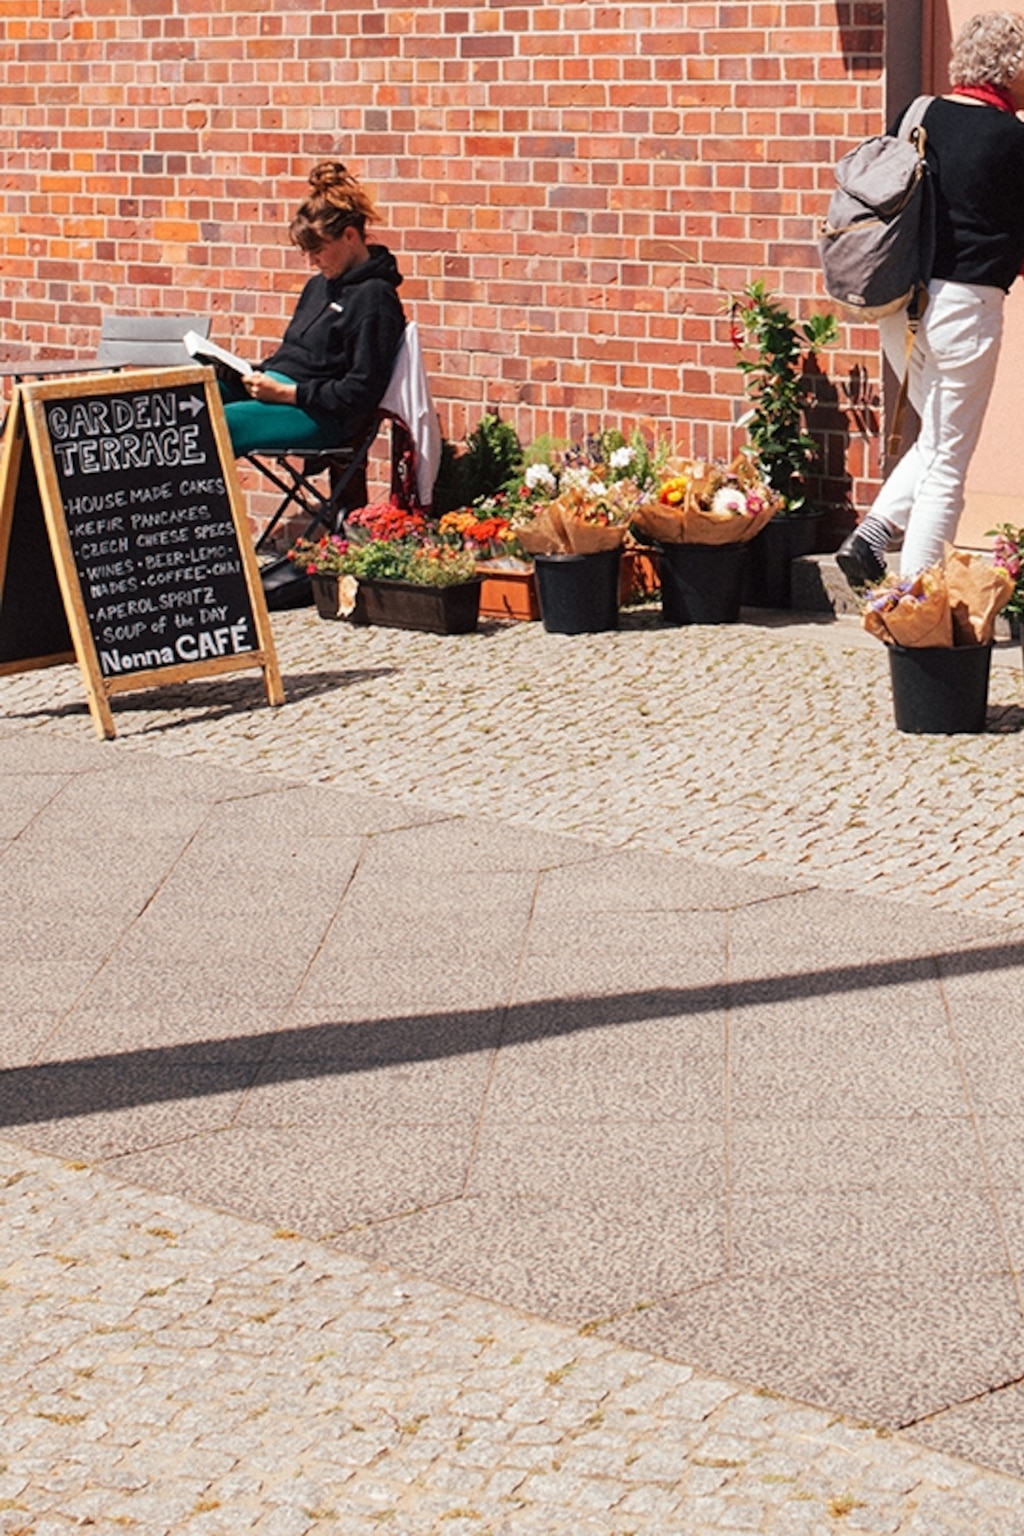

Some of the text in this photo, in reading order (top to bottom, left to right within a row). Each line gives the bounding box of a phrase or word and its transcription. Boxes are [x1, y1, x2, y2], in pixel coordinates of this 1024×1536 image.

[49, 392, 177, 439] GARDEN
[54, 424, 206, 477] TERRACE
[68, 477, 226, 514] HOUSE MADE CAKES
[75, 505, 211, 537] KEFIR PANCAKES
[80, 537, 129, 560] CZECH
[136, 528, 189, 548] CHEESE
[86, 559, 134, 581] WINES
[145, 551, 185, 570] BEER
[90, 576, 138, 599] NADES
[147, 565, 207, 587] COFFEE
[96, 587, 217, 623] APEROL SPRITZ
[103, 605, 229, 644] SOUP of the DAY
[100, 616, 252, 674] Nonna CAFÉ
